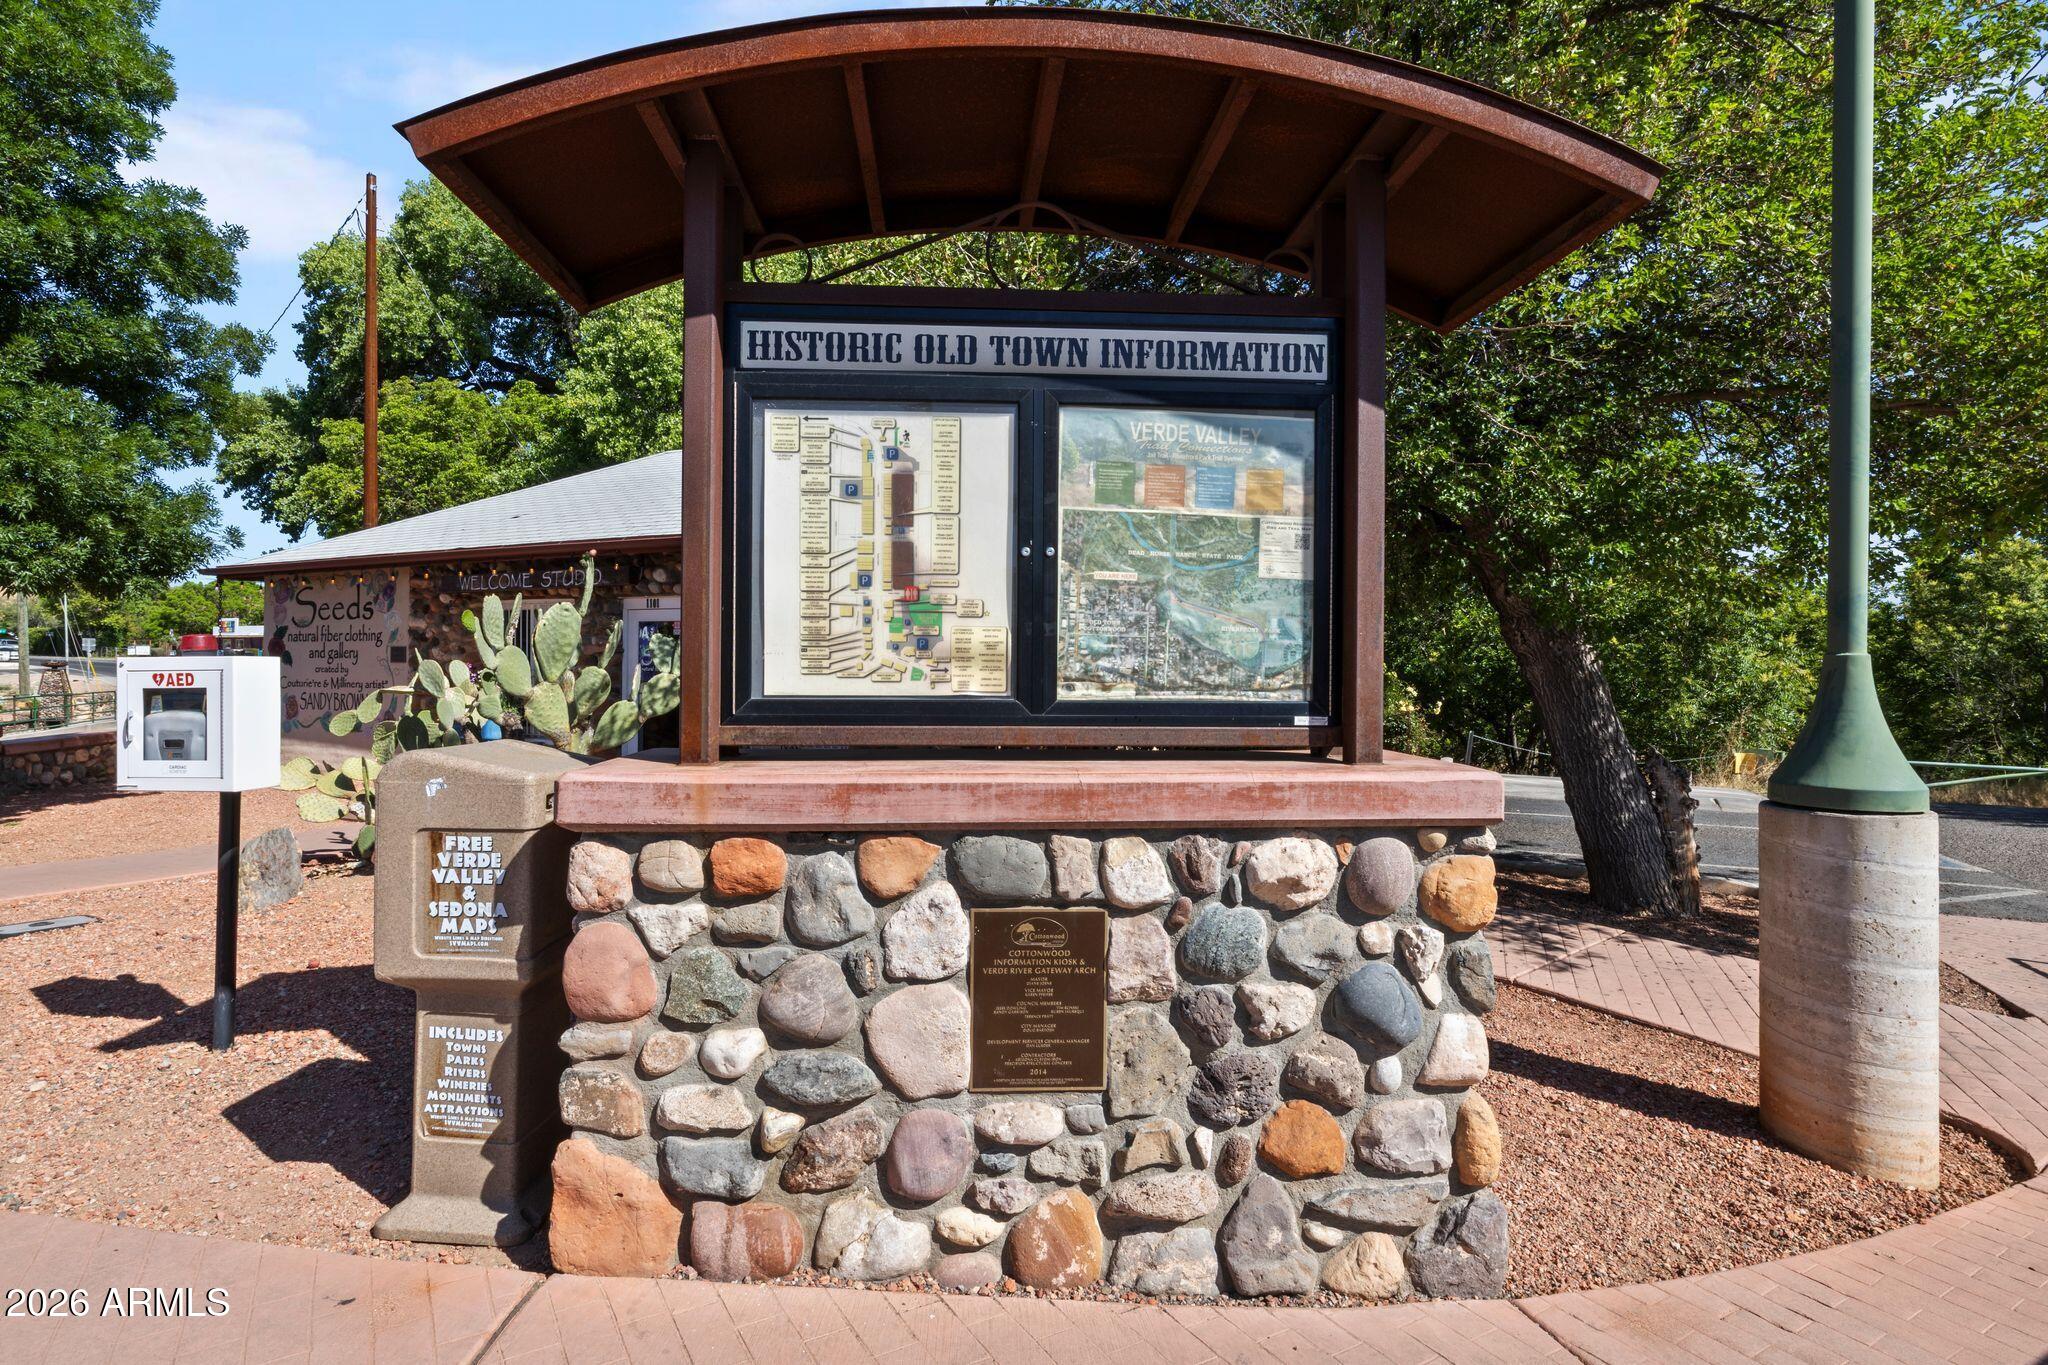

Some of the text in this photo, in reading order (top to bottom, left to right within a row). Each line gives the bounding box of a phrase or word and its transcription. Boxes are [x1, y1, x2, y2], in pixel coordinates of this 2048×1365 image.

[747, 329, 1326, 374] HISTORIC OLD TOWN INFORMATION
[1130, 421, 1263, 446] VERDE VALLEY
[1177, 442, 1253, 455] Connections
[459, 568, 602, 591] WELCOME STUDO
[291, 583, 375, 629] Seeds
[287, 624, 383, 648] natural fiber clothing
[308, 642, 359, 666] and gallery
[314, 663, 349, 676] created by
[165, 672, 195, 687] AED
[322, 680, 330, 688] &
[330, 677, 364, 693] Millinery
[299, 691, 332, 711] SANDY
[444, 835, 494, 852] FREE
[437, 852, 502, 869] VERDE
[431, 868, 508, 885] VALLEY
[462, 885, 478, 902] &
[428, 901, 509, 919] SEDONA
[440, 917, 499, 935] MAPS
[1008, 949, 1071, 957] COTTONWOOD
[982, 966, 1097, 975] VERDE RIVER GATEWAY ARCH
[993, 958, 1052, 966] INFORMATION
[1053, 958, 1078, 966] KIOSK
[428, 1026, 505, 1043] INCLUDES
[445, 1041, 488, 1054] TOWNS
[446, 1054, 485, 1066] PARKS
[444, 1066, 487, 1079] RIVERS
[437, 1078, 493, 1092] WINERIES
[426, 1090, 502, 1105] MONUMENTS
[423, 1103, 505, 1118] ATTRACTIONS
